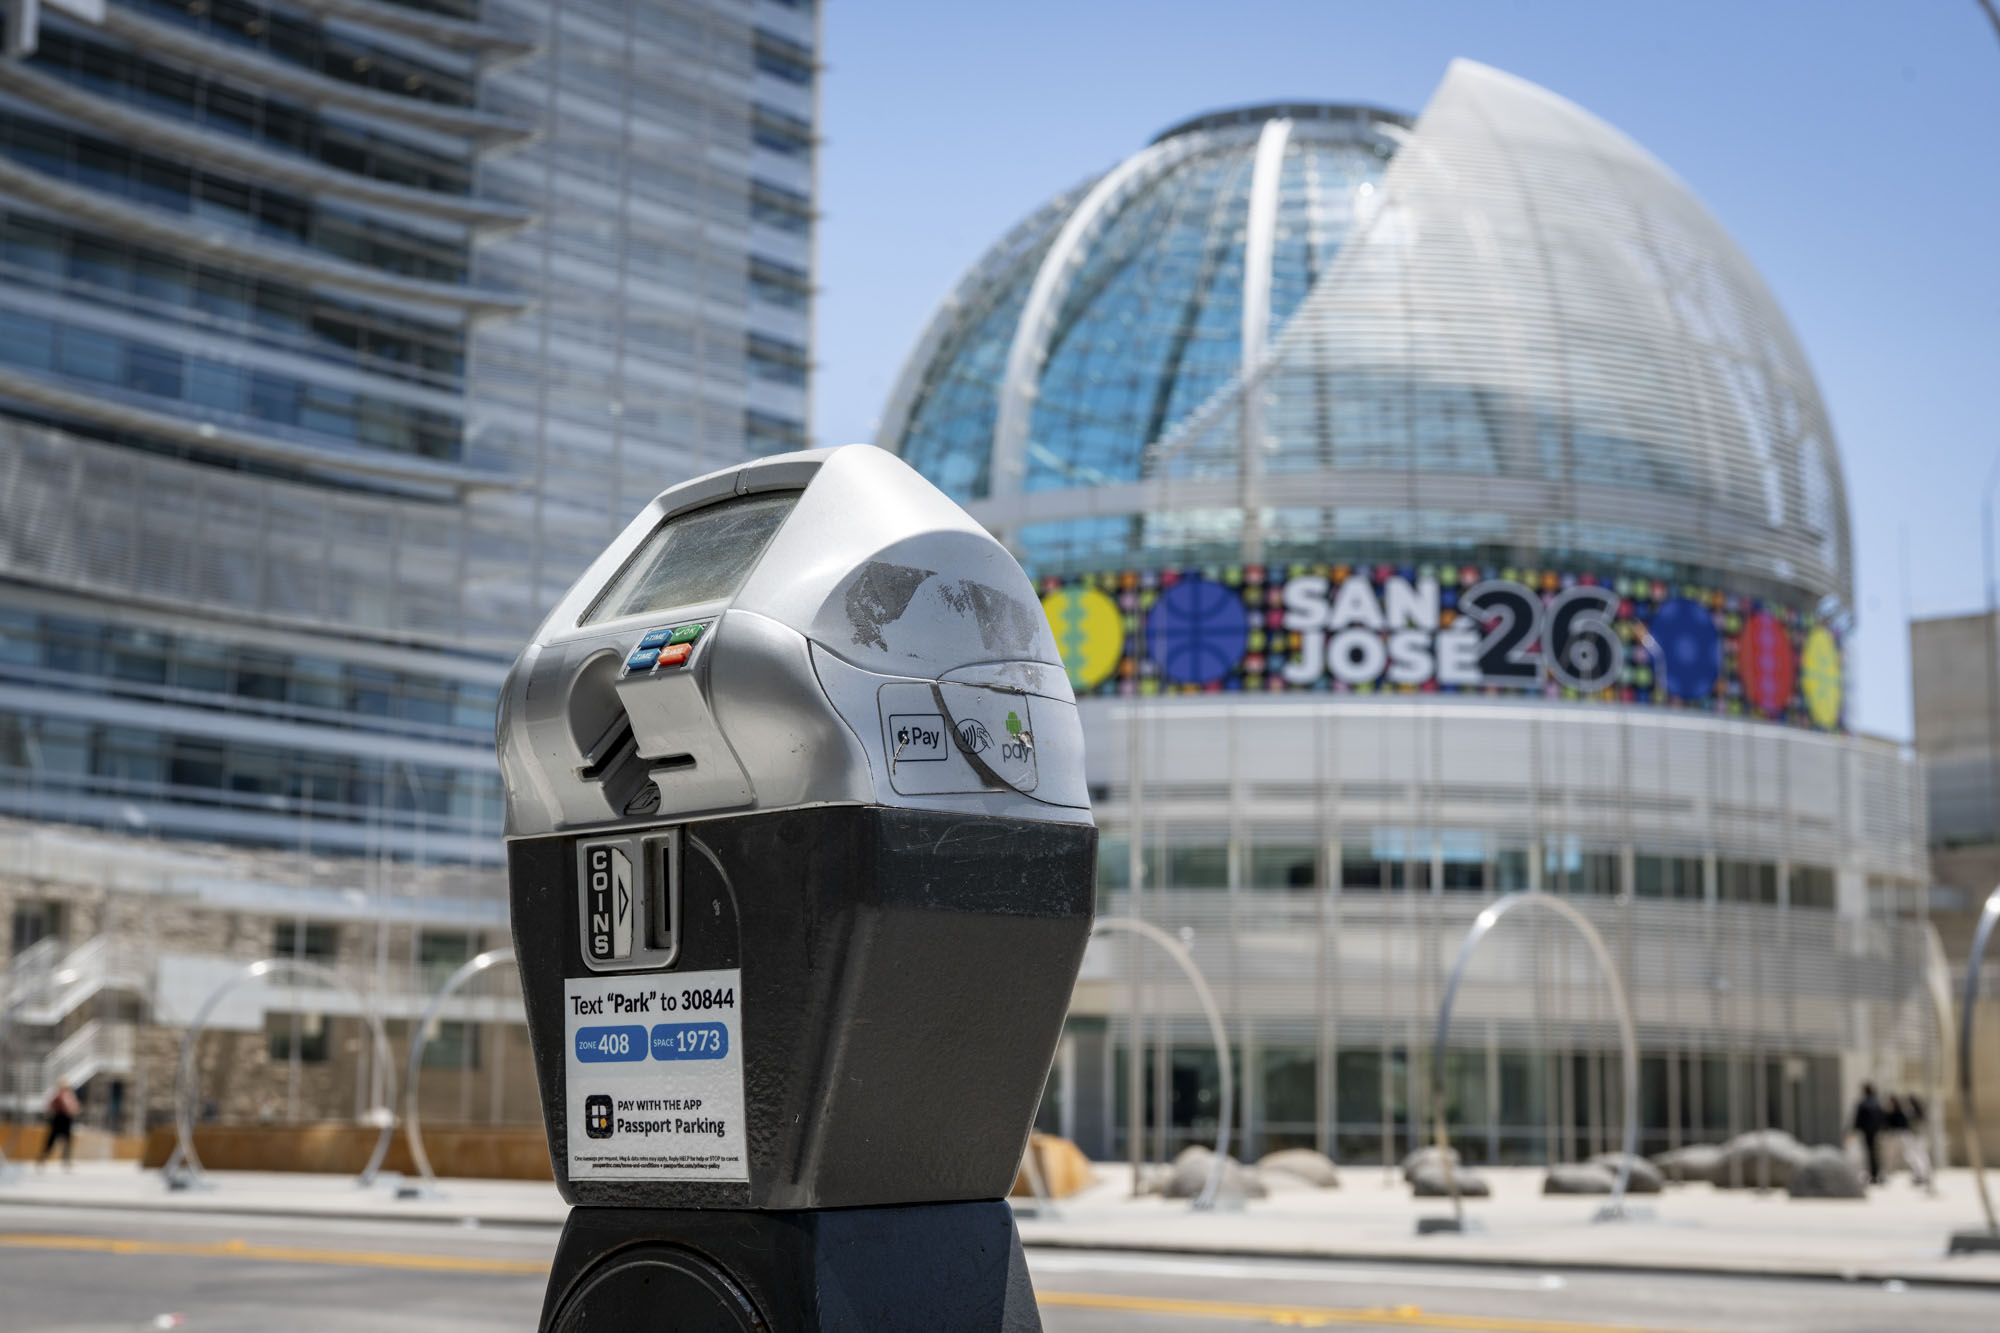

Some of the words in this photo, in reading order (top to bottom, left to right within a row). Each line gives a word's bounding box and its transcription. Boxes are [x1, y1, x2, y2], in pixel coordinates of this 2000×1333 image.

[1283, 574, 1441, 631] SAN
[1459, 577, 1626, 692] 26
[1283, 615, 1484, 686] JOSÉ
[912, 727, 940, 749] Pay
[1002, 742, 1030, 763] pay
[592, 850, 609, 954] COINS
[570, 996, 603, 1015] Text
[660, 991, 677, 1011] to
[681, 988, 734, 1011] 30844
[579, 1041, 597, 1050] ZONE
[598, 1033, 630, 1055] 408
[653, 1038, 674, 1047] SPACE
[676, 1030, 721, 1052] 1973
[617, 1100, 635, 1111] PAY
[636, 1100, 662, 1111] WITH
[663, 1100, 681, 1111] THE
[683, 1099, 702, 1110] APP
[617, 1118, 672, 1137] Passport
[675, 1117, 725, 1138] Parking
